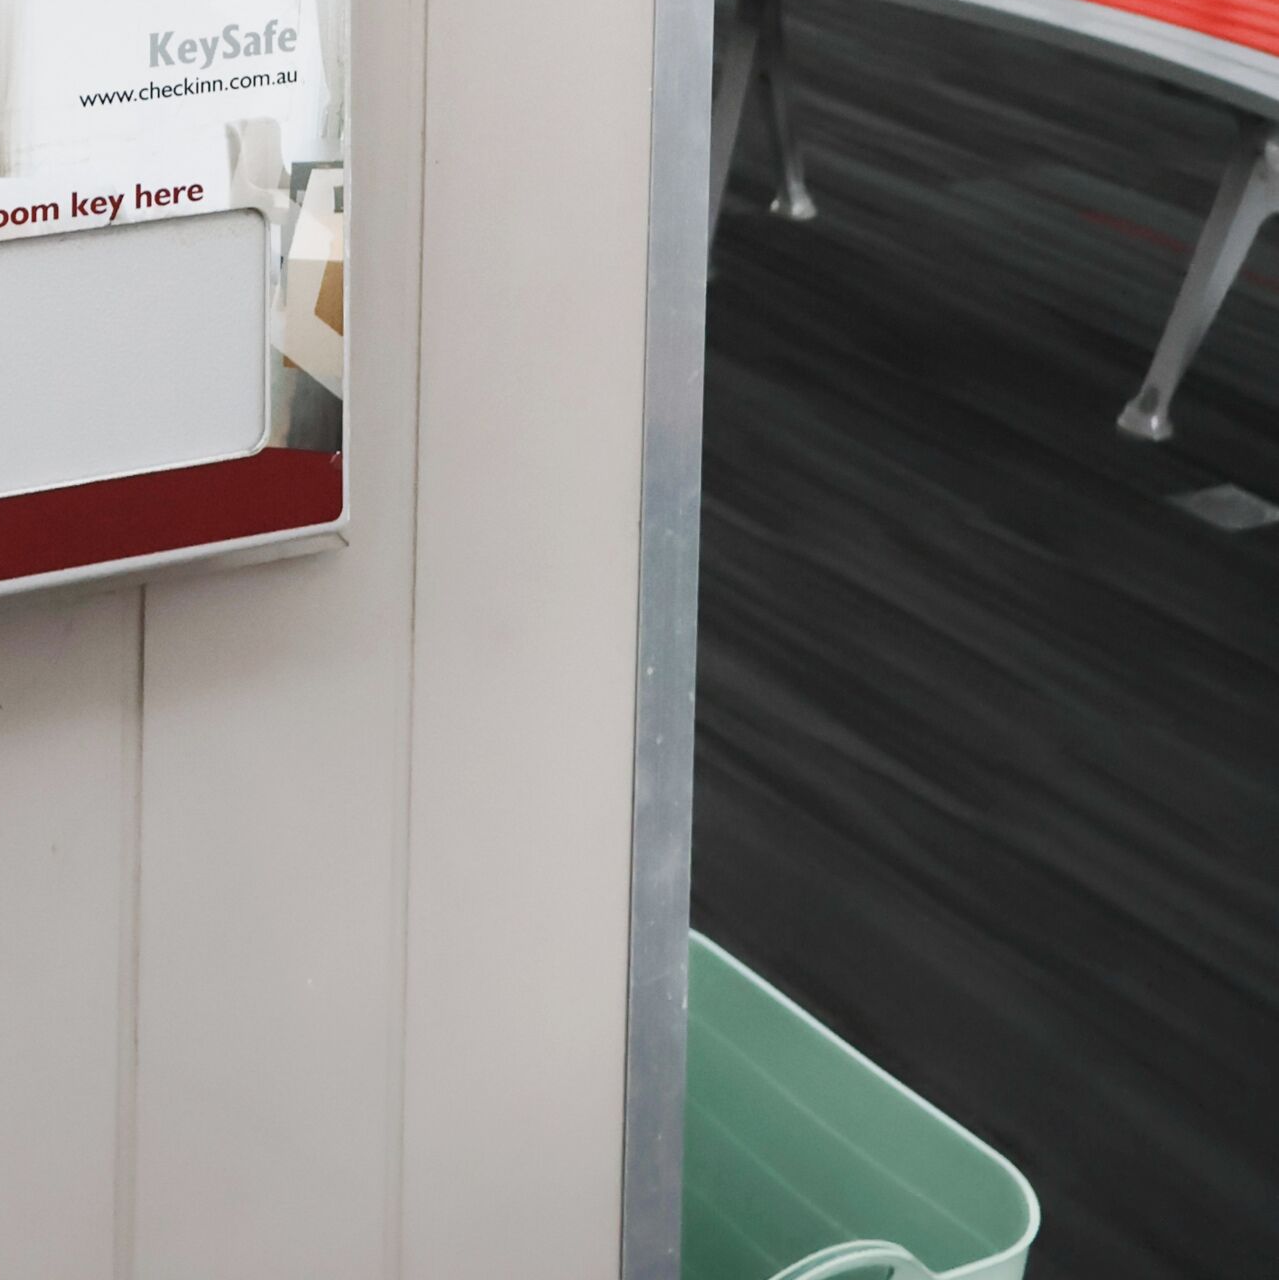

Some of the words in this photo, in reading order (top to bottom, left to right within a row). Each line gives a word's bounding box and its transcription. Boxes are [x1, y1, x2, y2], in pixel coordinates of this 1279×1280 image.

[149, 18, 298, 70] KeySafe
[79, 70, 298, 108] www.checkinn.com.au
[71, 191, 125, 222] key
[135, 183, 204, 209] here
